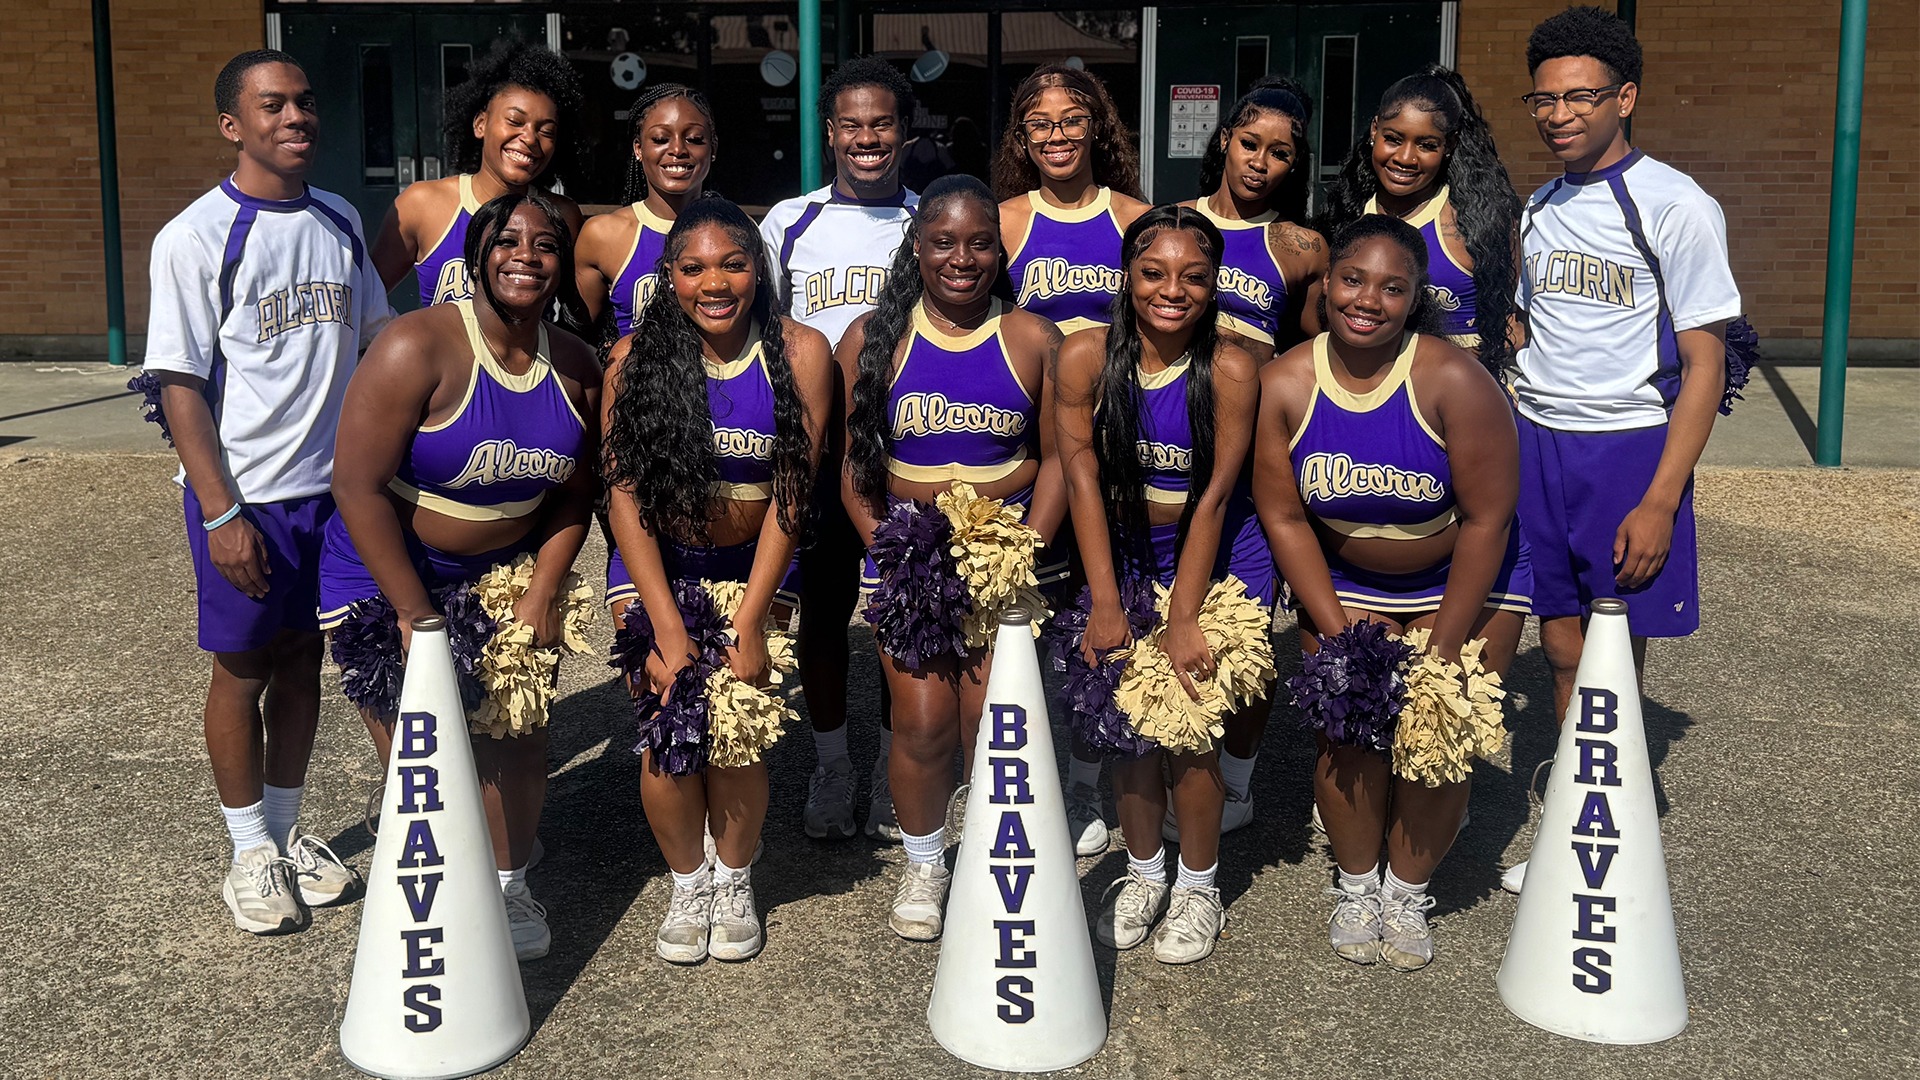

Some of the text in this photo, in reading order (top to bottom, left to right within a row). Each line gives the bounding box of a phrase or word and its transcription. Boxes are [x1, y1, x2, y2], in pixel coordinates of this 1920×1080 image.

[805, 265, 886, 317] ALCO
[1216, 266, 1274, 311] orn
[890, 392, 1027, 440] Alcorn
[440, 438, 576, 486] Alcorn
[1300, 452, 1445, 505] Alcorn
[988, 703, 1037, 1025] BRAVES
[1571, 686, 1622, 994] BRAVES
[396, 711, 445, 1033] BRAVES
